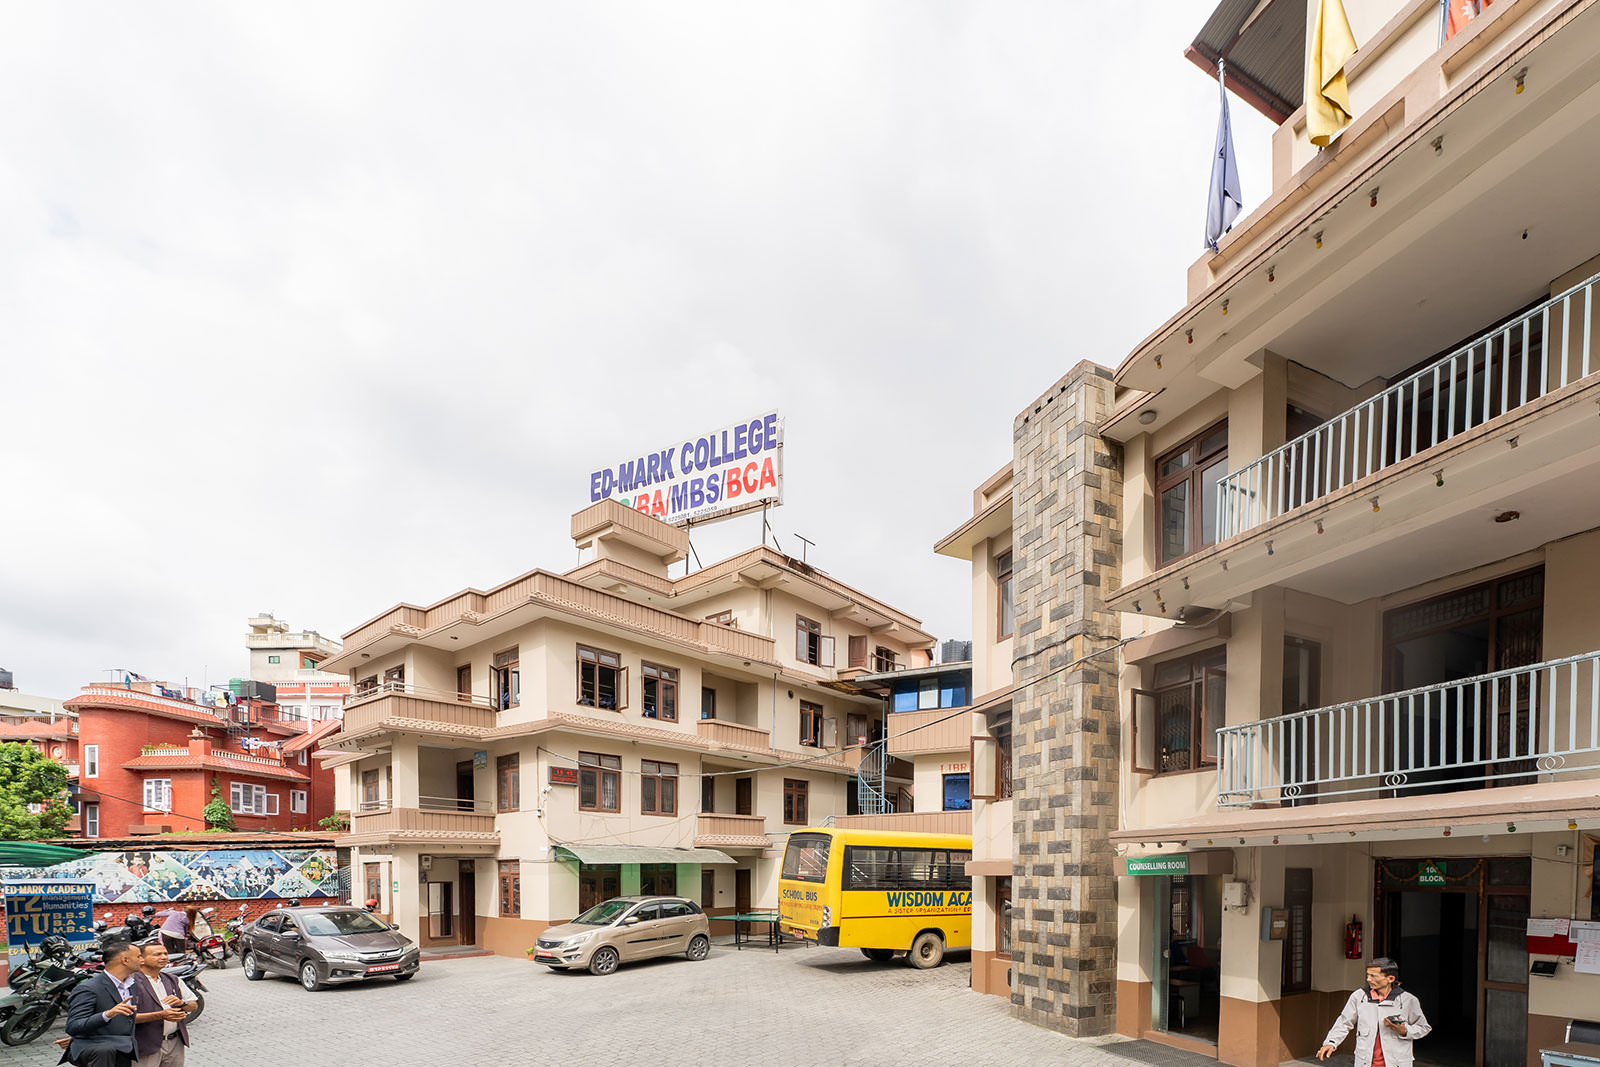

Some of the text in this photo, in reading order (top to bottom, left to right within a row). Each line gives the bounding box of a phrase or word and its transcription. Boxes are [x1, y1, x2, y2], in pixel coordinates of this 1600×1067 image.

[591, 413, 777, 503] ED-MARK COLLEGE
[1129, 861, 1185, 871] COUNSELLING ROOM
[5, 885, 93, 894] ED-MARK ACADEMY
[783, 889, 818, 901] SCHOOL BUS
[887, 892, 943, 907] WISDOM
[43, 902, 89, 910] Humanities
[8, 913, 50, 935] TU
